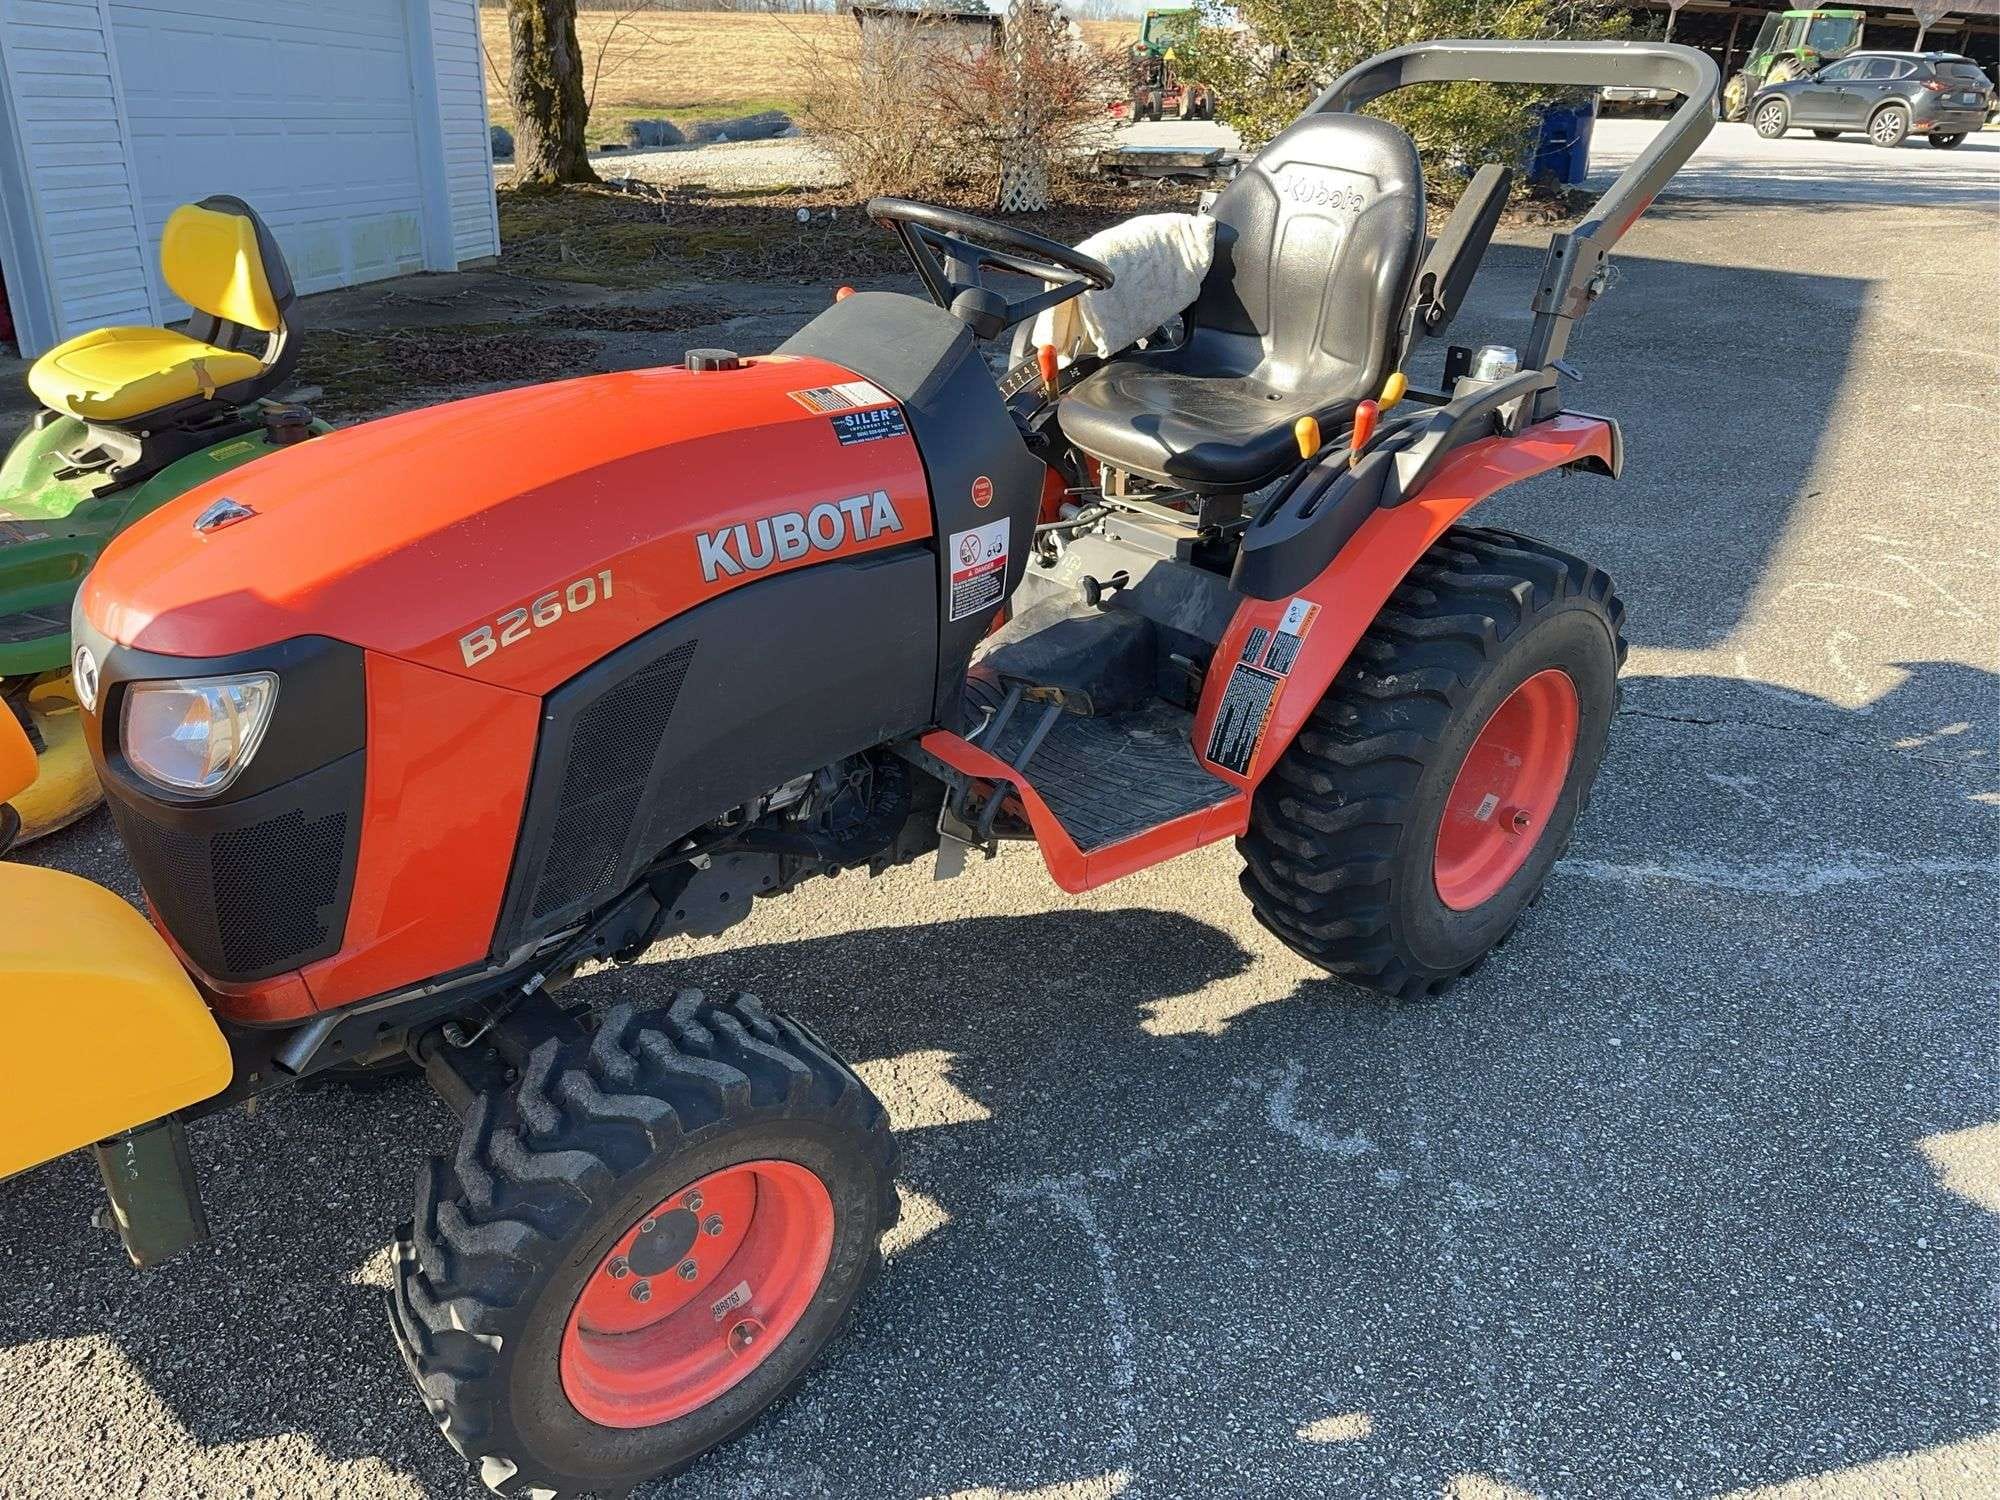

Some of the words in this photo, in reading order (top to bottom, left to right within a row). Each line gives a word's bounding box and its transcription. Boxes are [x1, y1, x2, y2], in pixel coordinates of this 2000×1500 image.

[1007, 379, 1014, 388] 2
[1015, 373, 1022, 381] 3
[1023, 366, 1030, 374] 4
[1031, 361, 1038, 369] 5
[844, 409, 891, 426] SILER
[696, 489, 904, 583] KUBOTA
[459, 569, 614, 668] B2601
